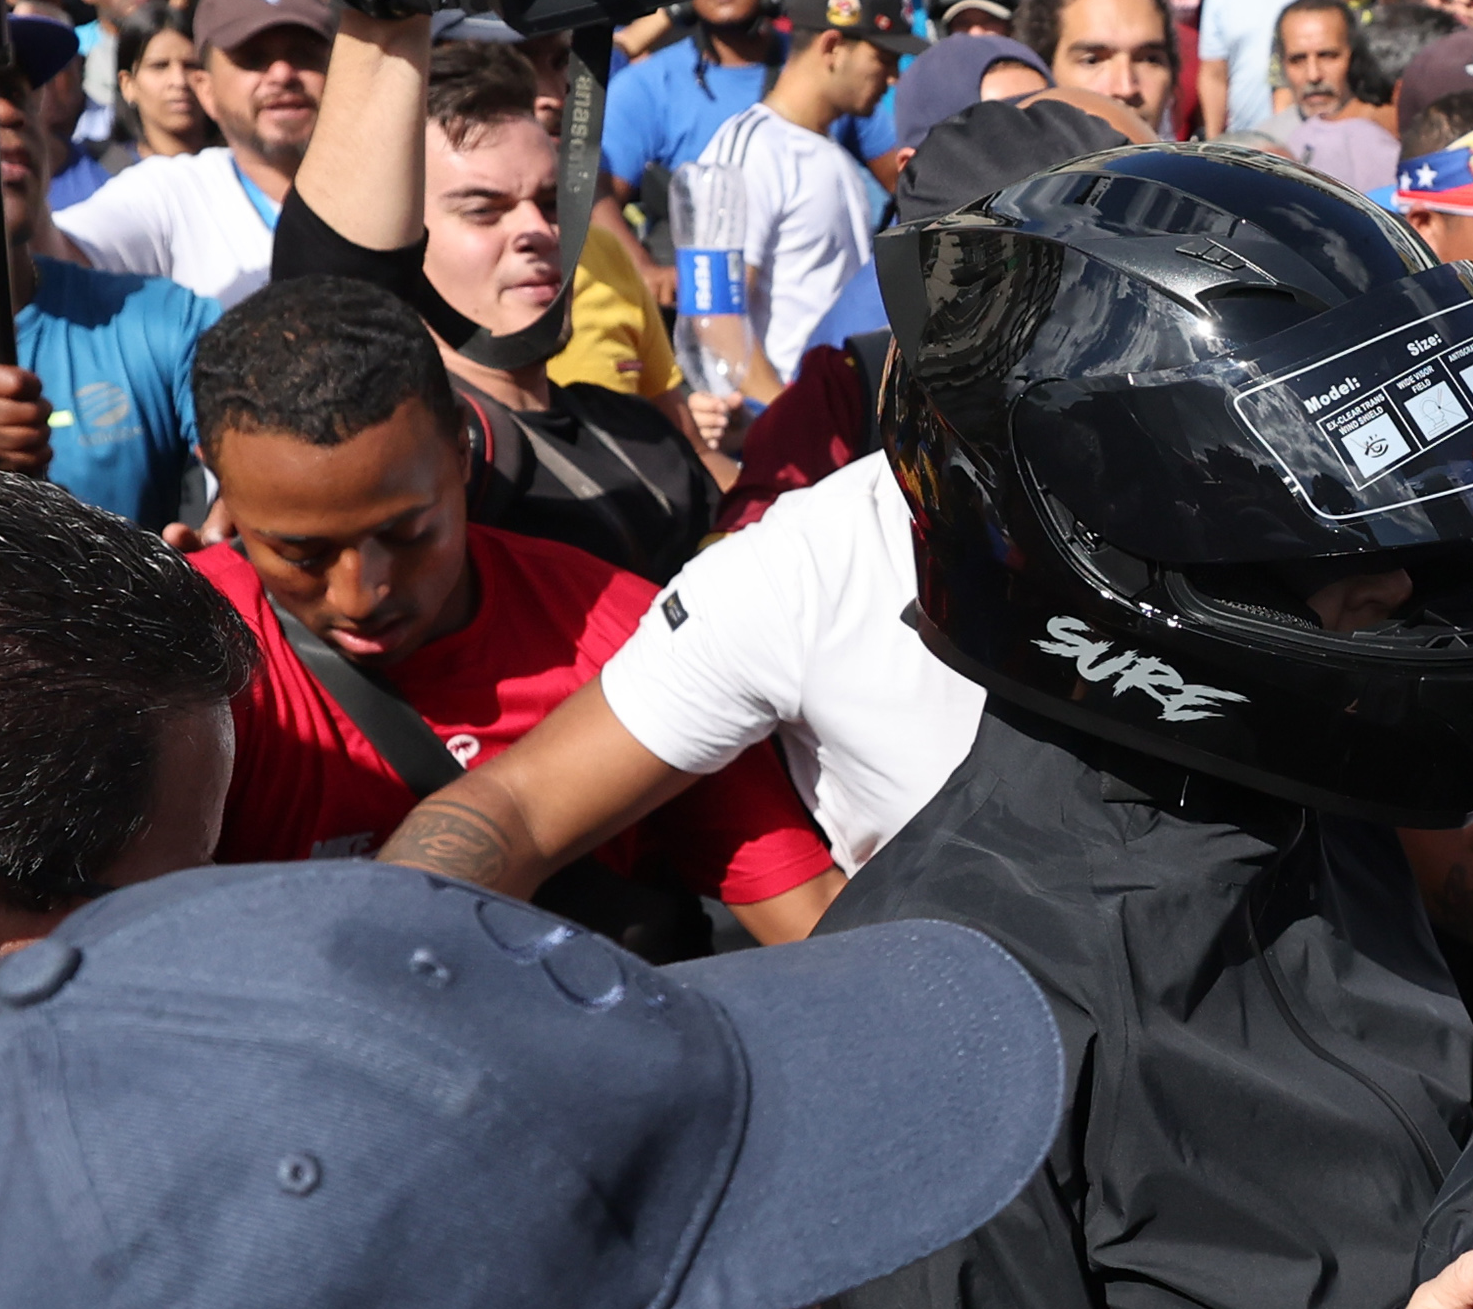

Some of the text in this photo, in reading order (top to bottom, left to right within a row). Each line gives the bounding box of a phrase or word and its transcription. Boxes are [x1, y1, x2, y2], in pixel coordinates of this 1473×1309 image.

[1406, 333, 1443, 357] Size:
[1395, 364, 1435, 390] WIDE VISOR
[1411, 378, 1432, 394] FIELD
[1303, 377, 1361, 414] Model:
[1326, 393, 1386, 432] EX-CLEAR TRANS
[1338, 405, 1384, 436] WIND SHIELD
